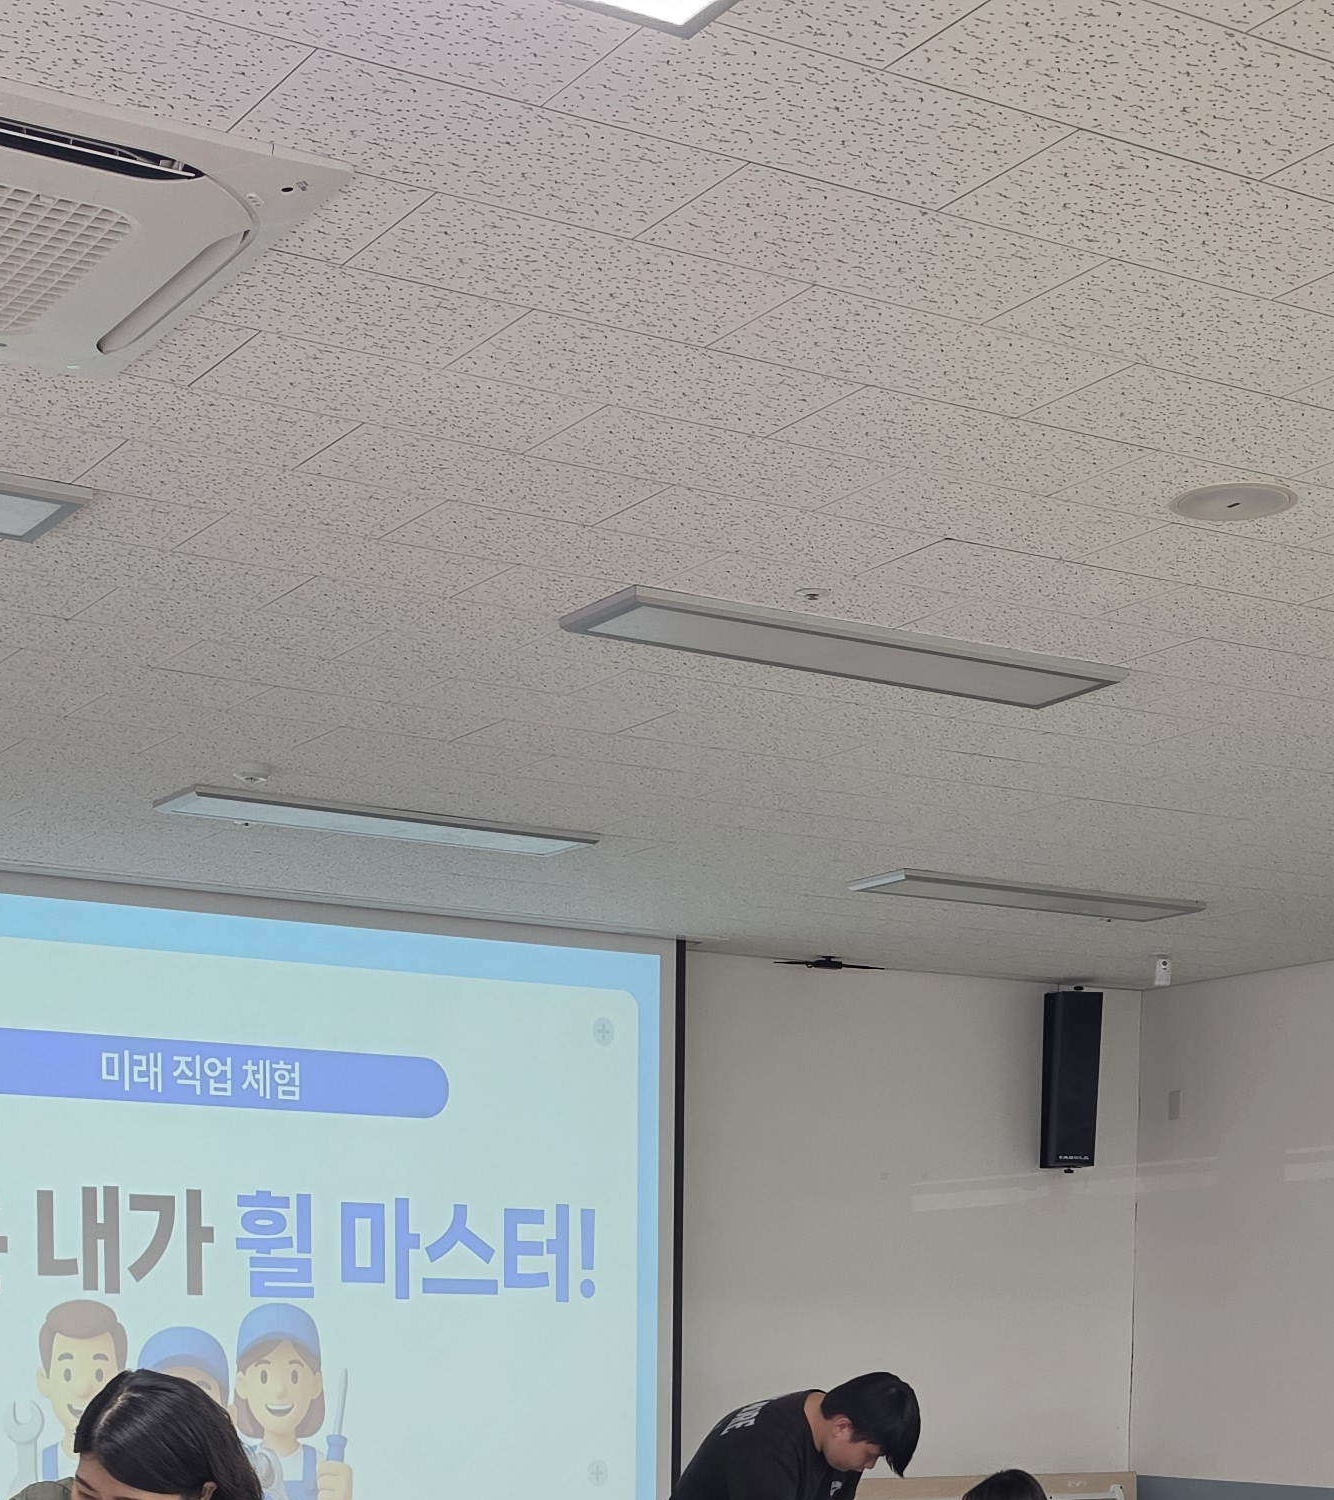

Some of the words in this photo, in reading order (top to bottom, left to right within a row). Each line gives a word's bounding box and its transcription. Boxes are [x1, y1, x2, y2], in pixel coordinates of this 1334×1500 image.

[101, 1049, 162, 1093] 미래
[172, 1054, 232, 1096] 직업
[241, 1059, 300, 1100] 체험
[36, 1185, 215, 1295] 내가
[234, 1189, 315, 1299] 휠
[339, 1197, 598, 1303] 마스터!
